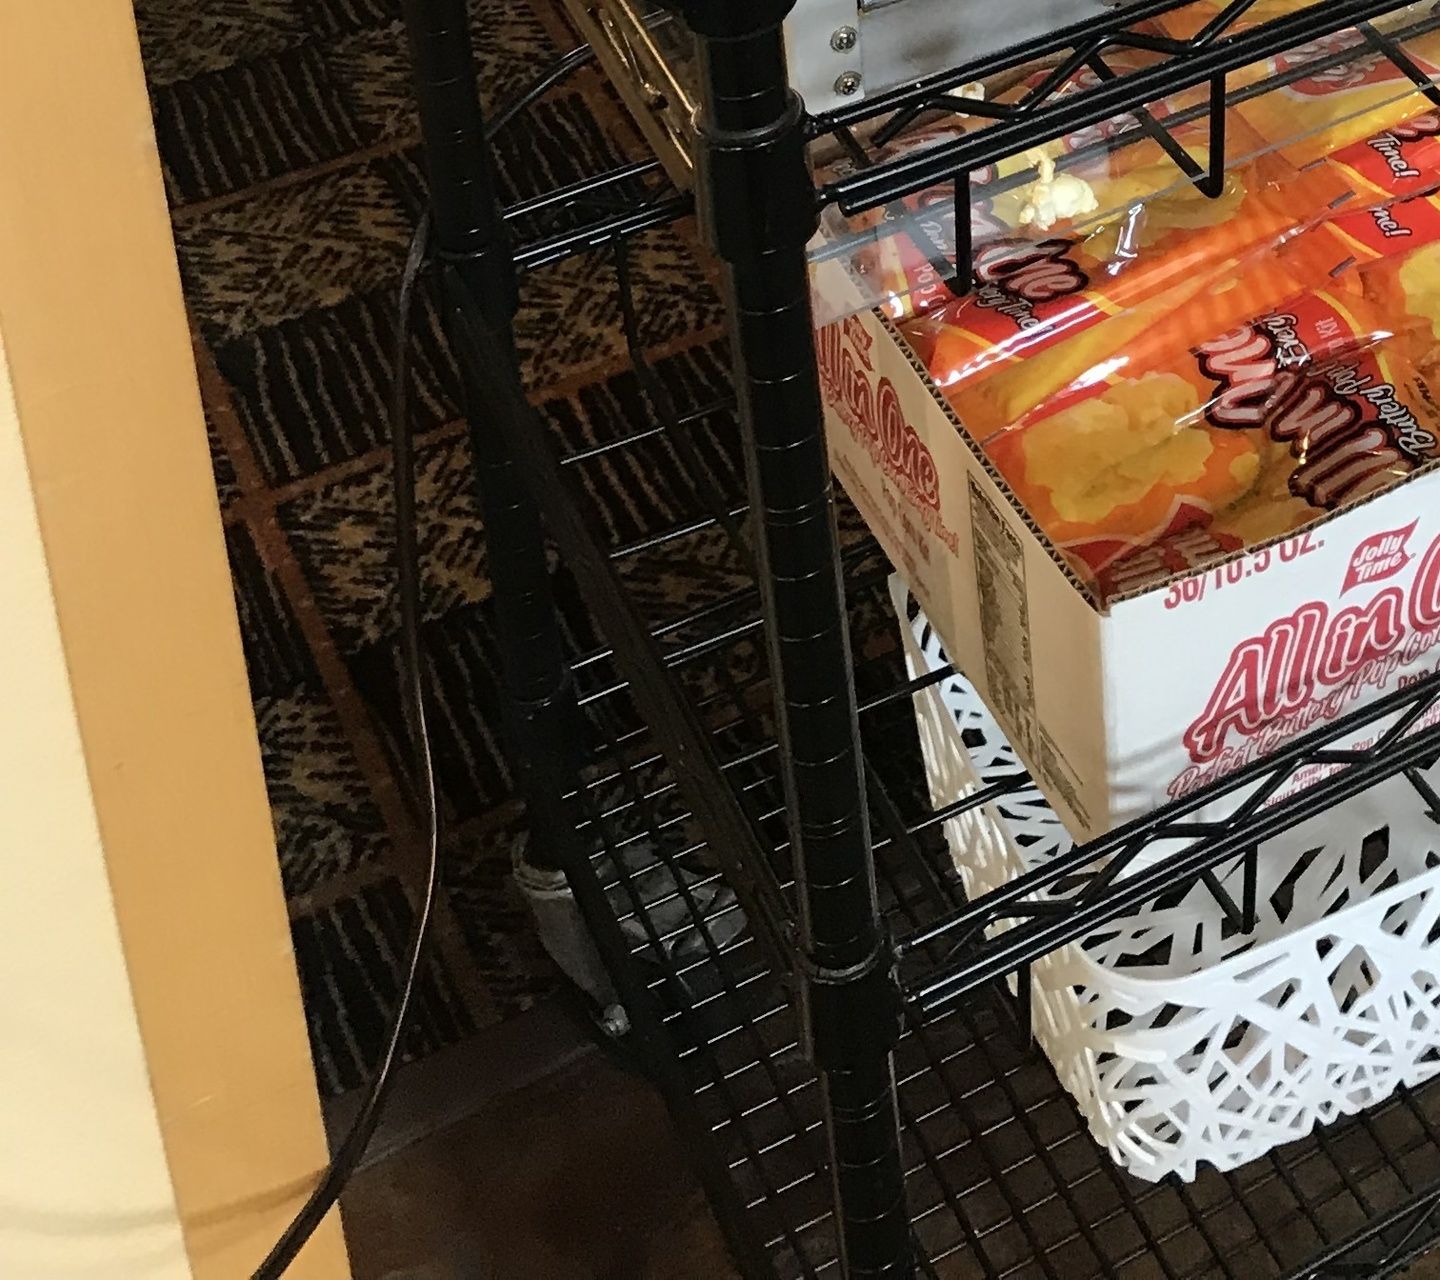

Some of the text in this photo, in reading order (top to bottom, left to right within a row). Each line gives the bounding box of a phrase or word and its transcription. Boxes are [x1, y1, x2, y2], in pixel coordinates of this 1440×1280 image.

[1366, 133, 1420, 183] Time!
[1368, 205, 1412, 239] me!
[1358, 382, 1438, 458] Buttery
[1352, 532, 1406, 567] Jolly
[1355, 551, 1402, 583] Time
[1182, 600, 1329, 764] All
[1316, 586, 1405, 686] in
